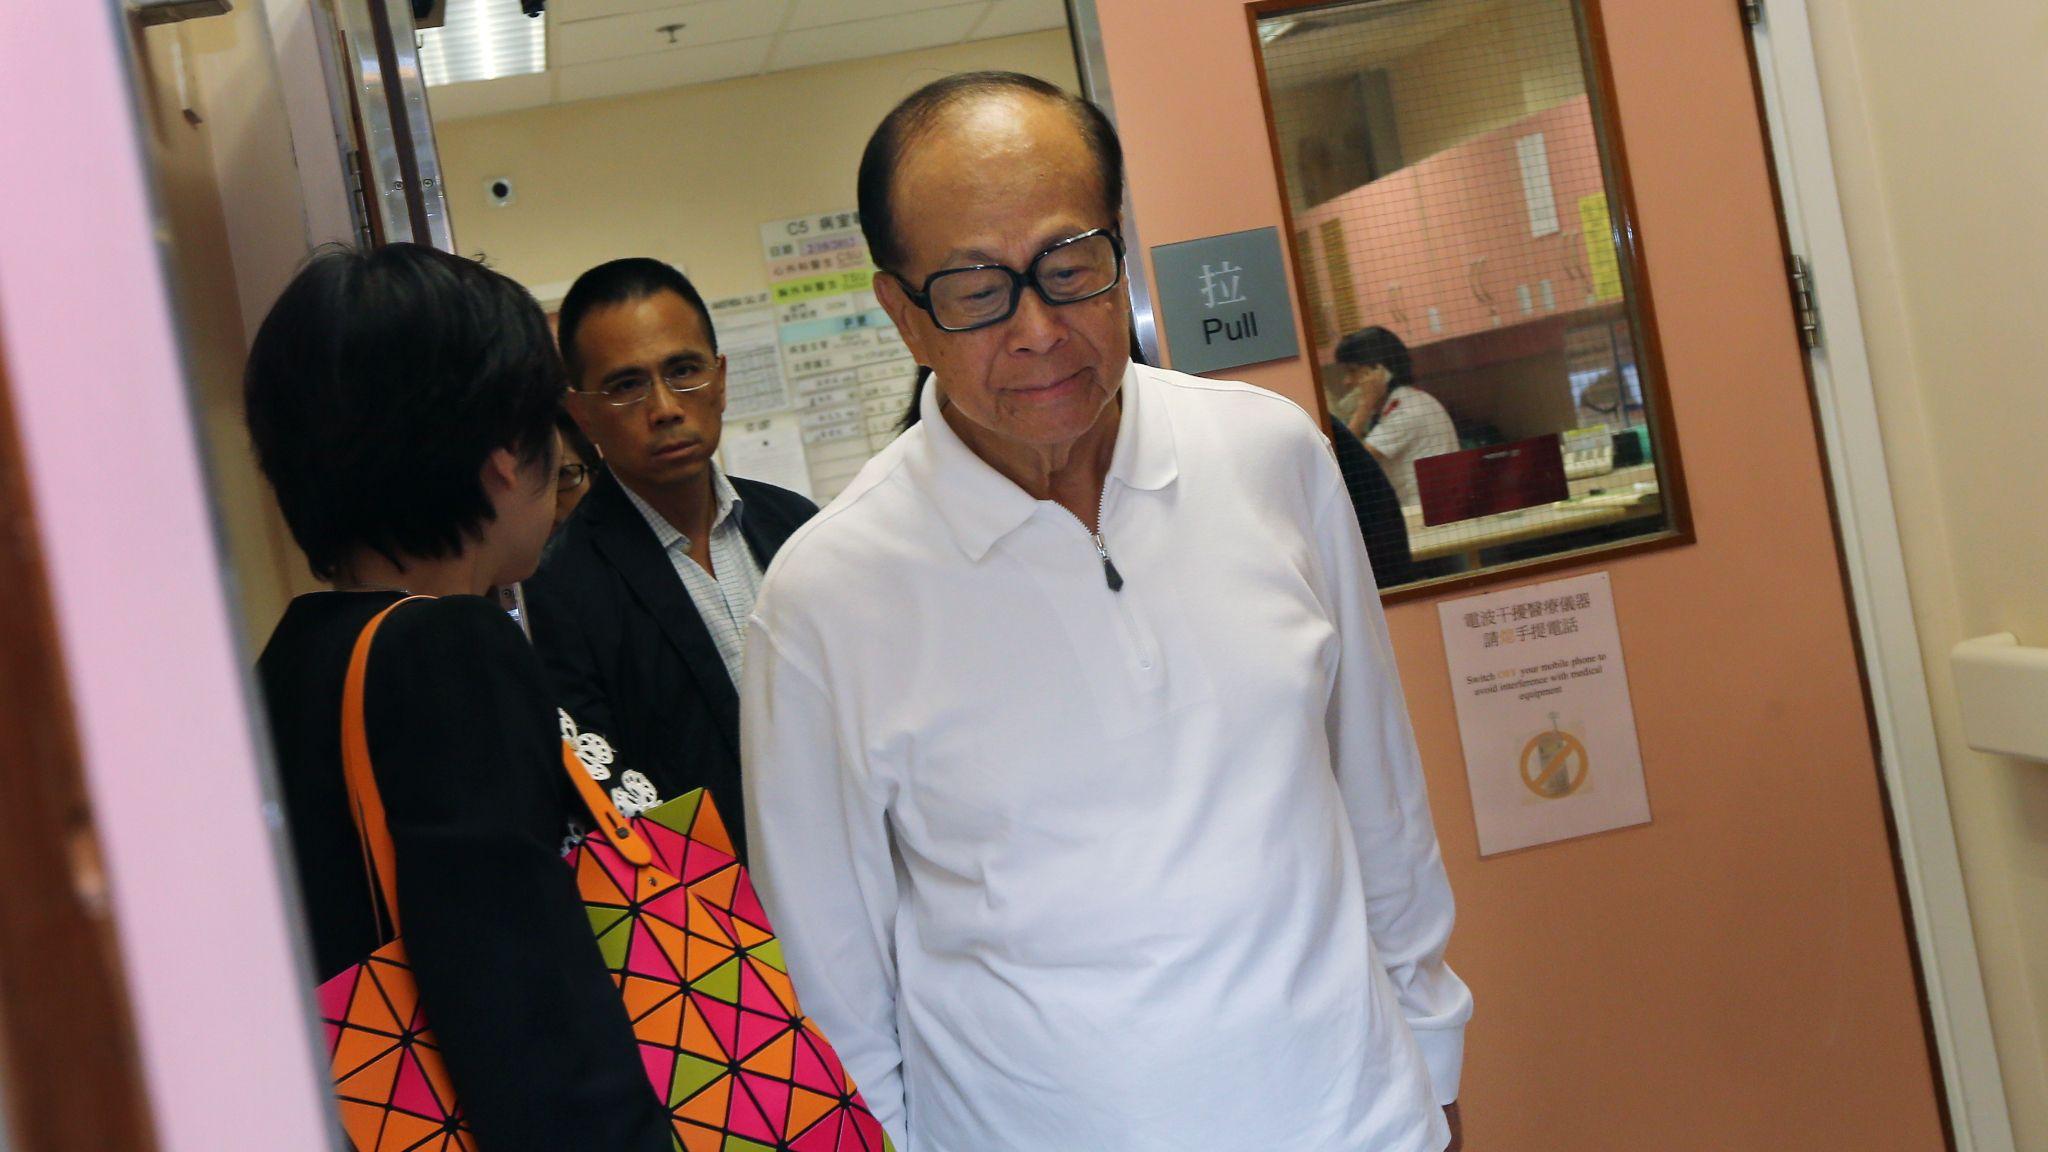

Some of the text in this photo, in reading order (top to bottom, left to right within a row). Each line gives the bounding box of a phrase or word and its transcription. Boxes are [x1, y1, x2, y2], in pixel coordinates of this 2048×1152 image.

[1199, 261, 1246, 308] 拉
[1202, 311, 1258, 345] Pull
[1464, 592, 1591, 629] 電波干擾醫療儀器
[1466, 672, 1496, 685] Switch
[1520, 665, 1539, 678] your
[1541, 659, 1570, 673] mobile
[1571, 654, 1597, 669] phone
[1597, 653, 1607, 662] to
[1474, 664, 1604, 697] avoid interference with medical
[1518, 685, 1563, 702] equipment
